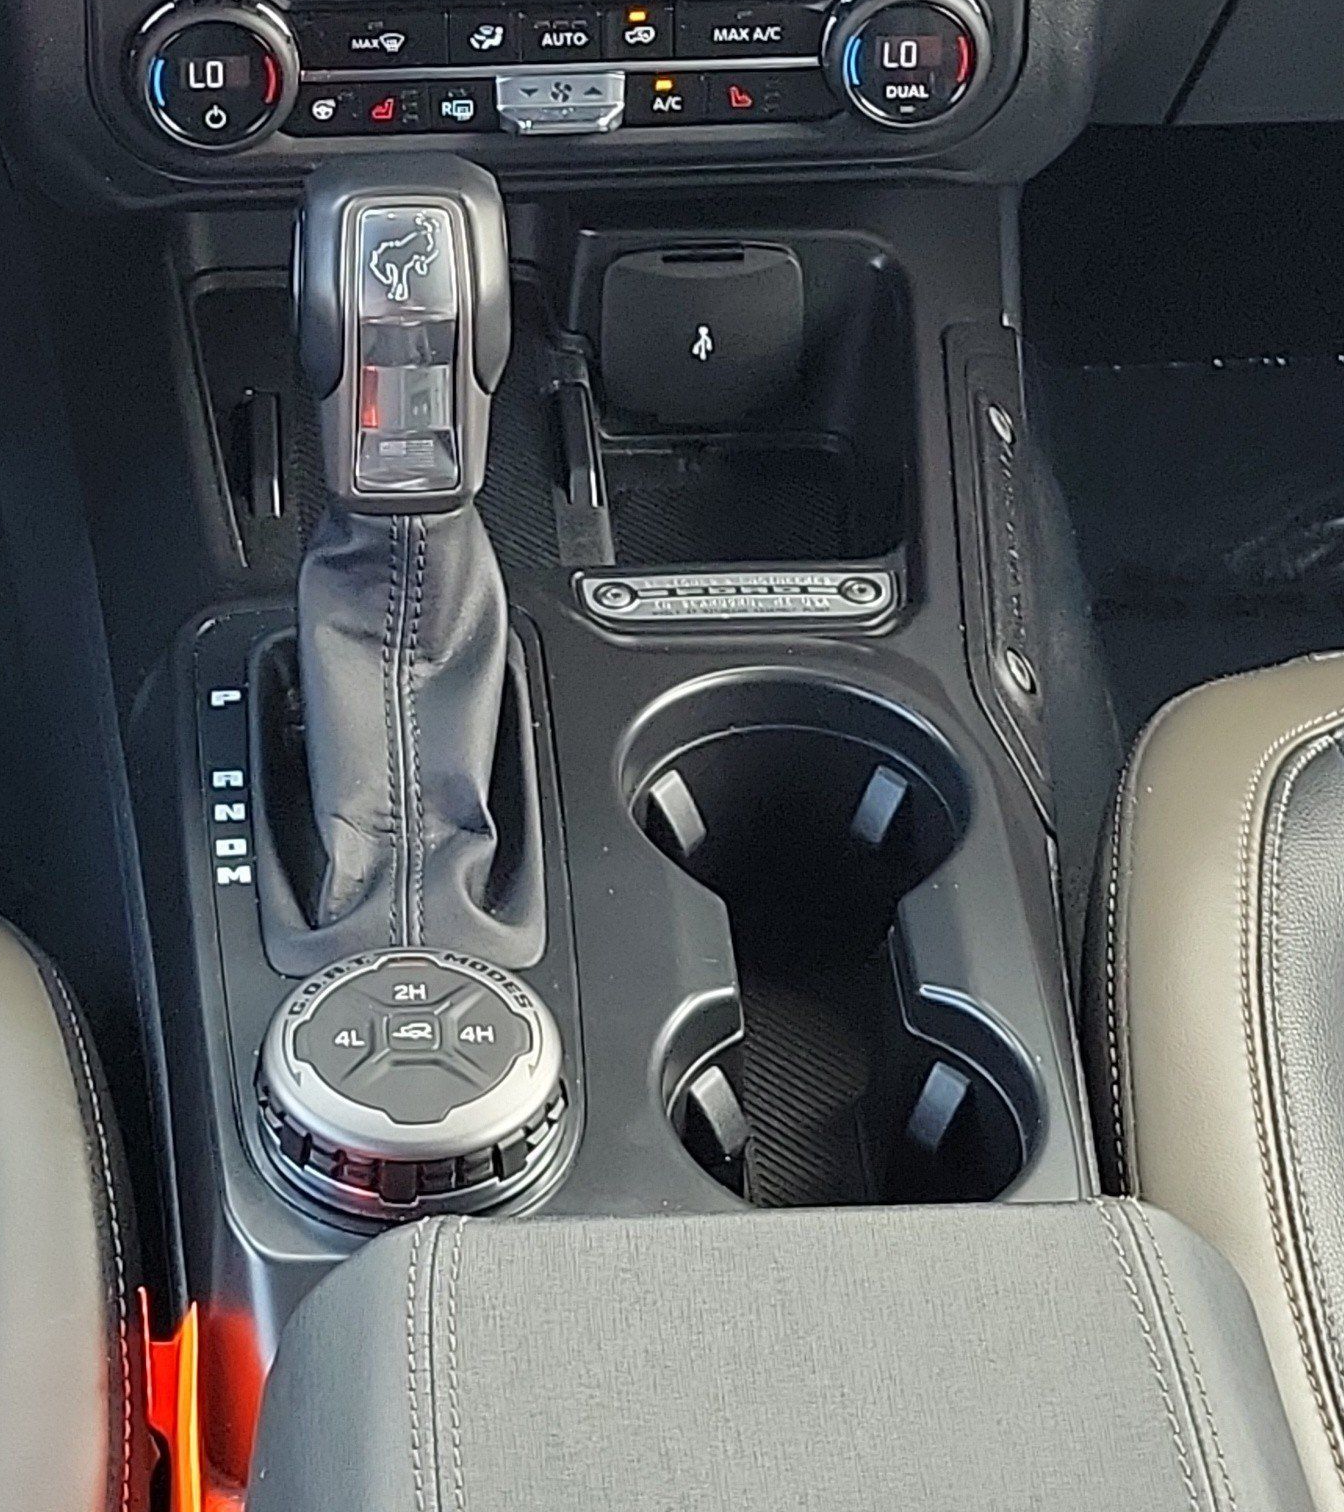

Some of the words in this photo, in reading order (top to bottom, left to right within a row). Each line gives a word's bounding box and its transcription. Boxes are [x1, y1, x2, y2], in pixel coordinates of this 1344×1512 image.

[541, 32, 589, 47] AUTO
[713, 27, 749, 43] MAX
[753, 26, 781, 42] A/C
[351, 37, 380, 51] MAX
[882, 39, 917, 69] LO
[188, 61, 224, 89] LO
[886, 85, 929, 100] DUAL
[653, 96, 682, 112] A/C
[211, 690, 241, 707] P
[212, 770, 243, 788] R
[214, 803, 246, 821] N
[215, 838, 247, 857] D
[216, 866, 252, 884] M
[443, 952, 533, 1009] MODES
[394, 983, 427, 1000] 2H
[334, 1029, 365, 1047] 4L
[460, 1025, 495, 1043] 4H
